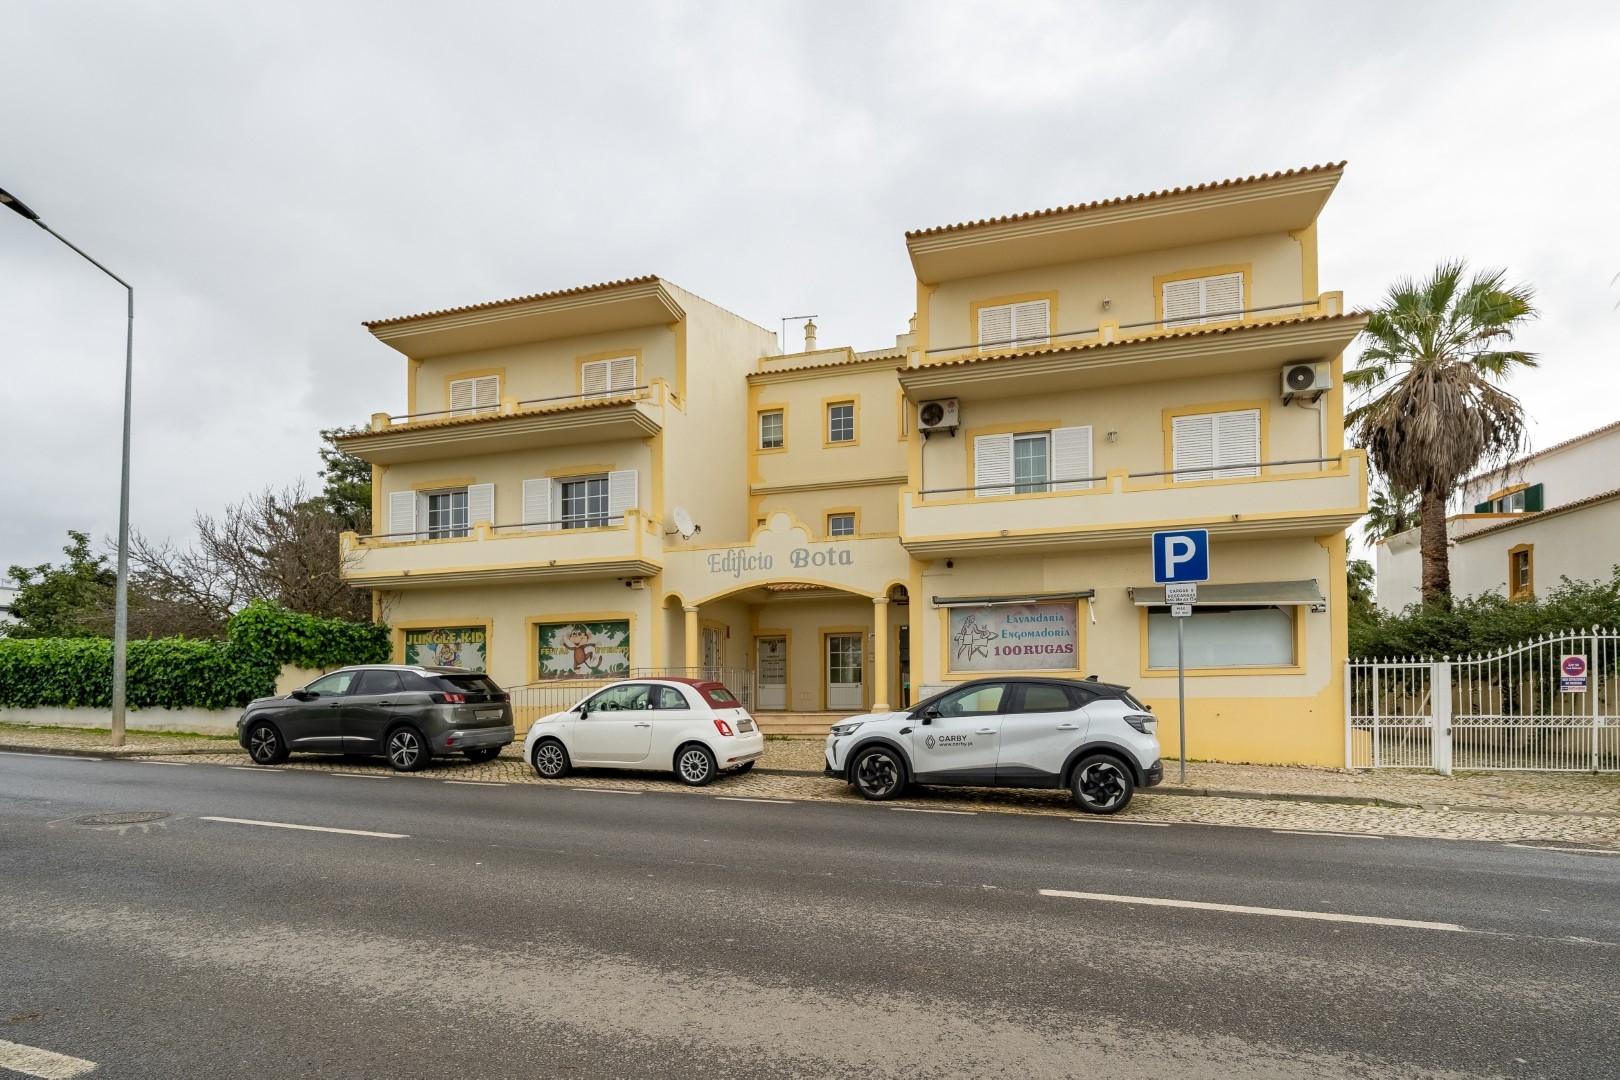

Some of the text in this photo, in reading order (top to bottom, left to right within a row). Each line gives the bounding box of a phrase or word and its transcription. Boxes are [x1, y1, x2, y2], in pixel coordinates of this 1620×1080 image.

[789, 546, 855, 569] Bota
[1165, 536, 1196, 578] P
[406, 631, 487, 645] JUNGLE KID
